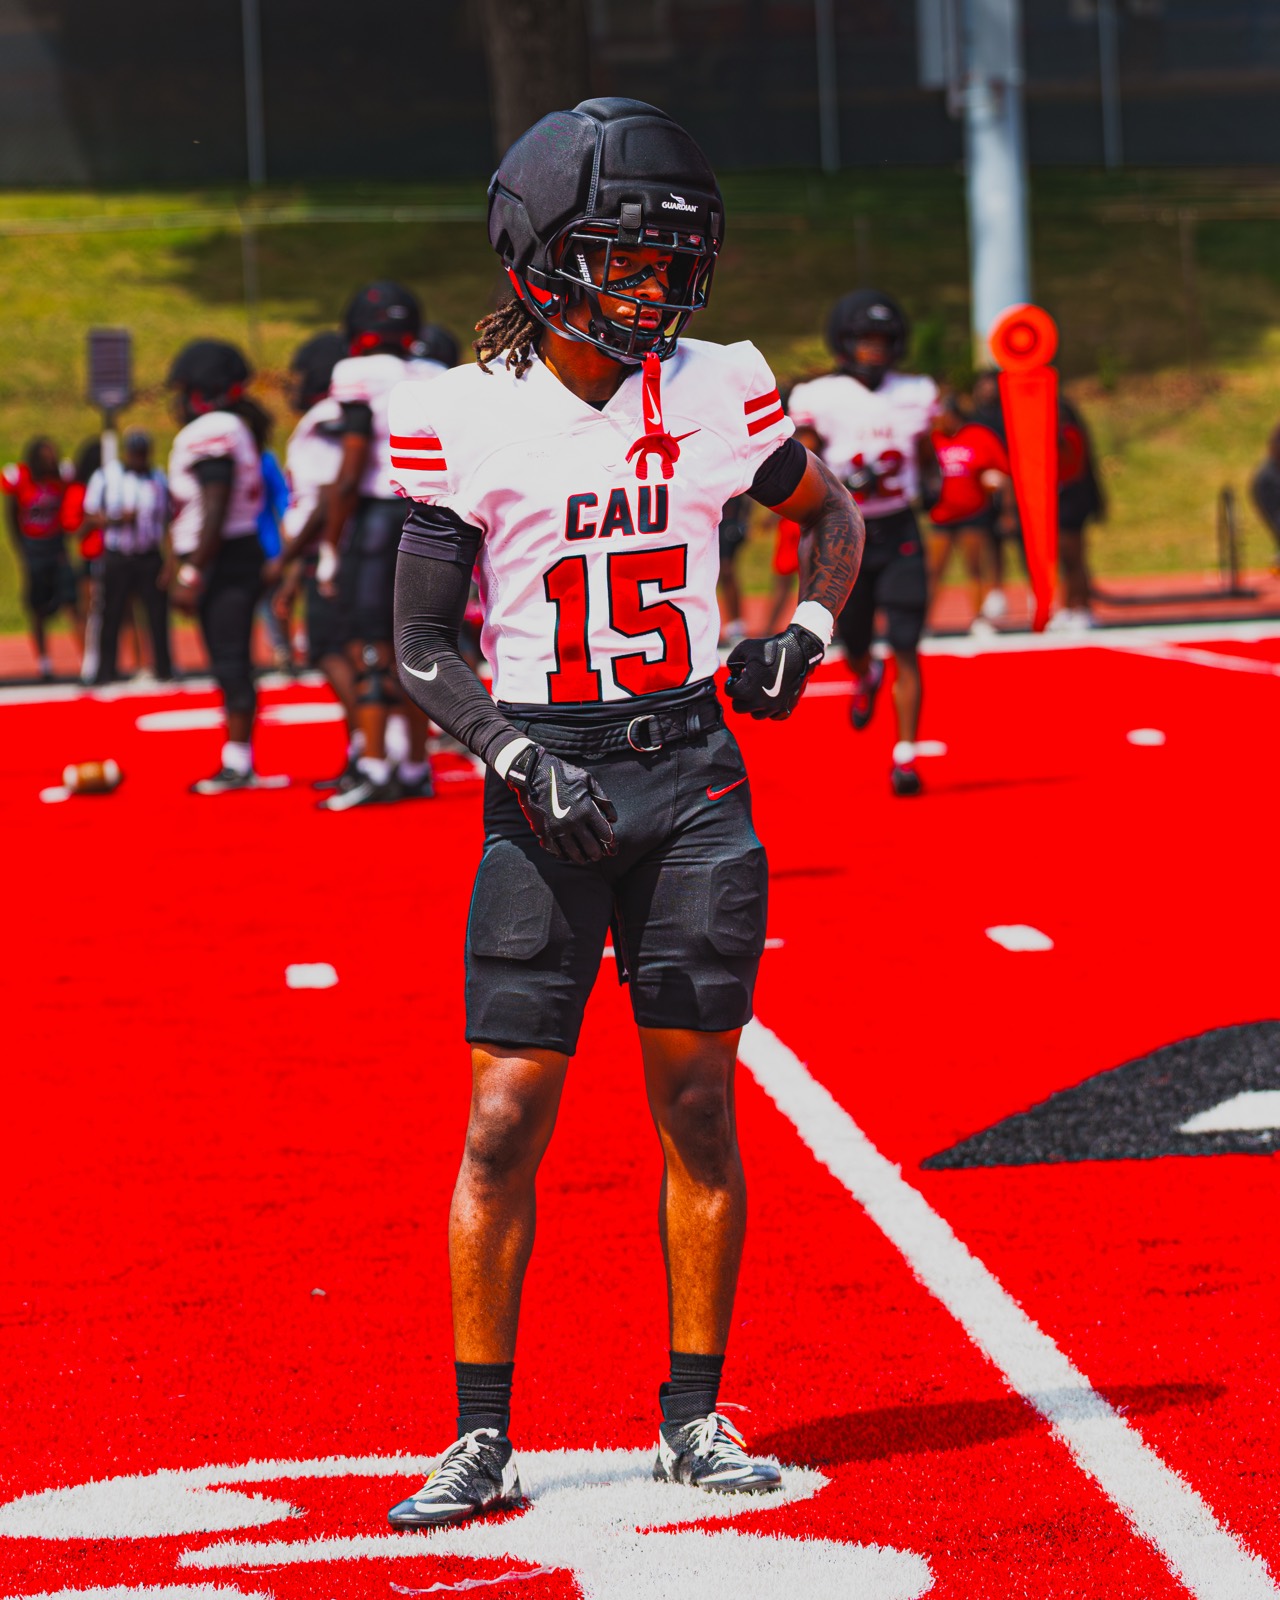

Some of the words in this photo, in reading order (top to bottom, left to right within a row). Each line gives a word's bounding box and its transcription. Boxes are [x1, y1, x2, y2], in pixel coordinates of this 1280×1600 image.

[661, 201, 698, 212] GUARDIAN
[577, 254, 591, 283] schutt
[565, 484, 669, 541] CAU
[543, 543, 693, 705] 15
